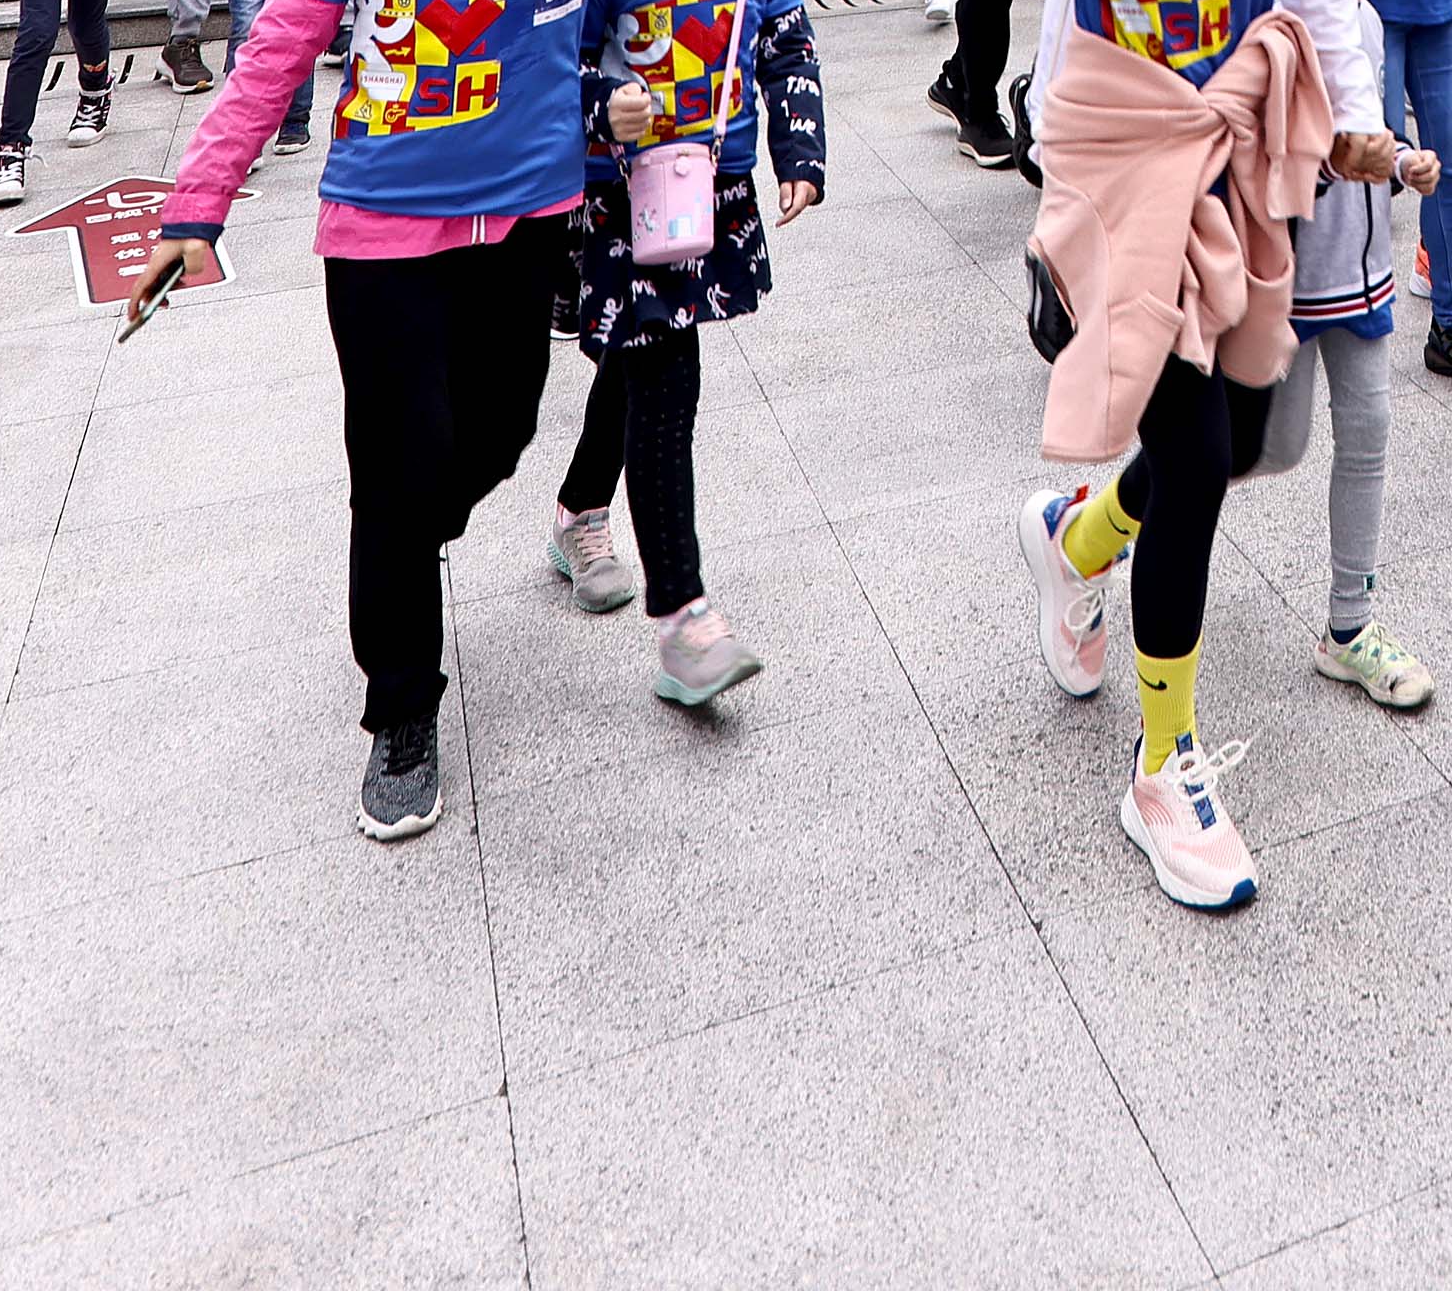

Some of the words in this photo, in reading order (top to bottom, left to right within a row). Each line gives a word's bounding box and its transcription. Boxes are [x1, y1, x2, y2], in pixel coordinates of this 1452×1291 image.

[1166, 6, 1229, 51] SH
[363, 74, 404, 85] SHANGHAI
[414, 73, 499, 114] SH
